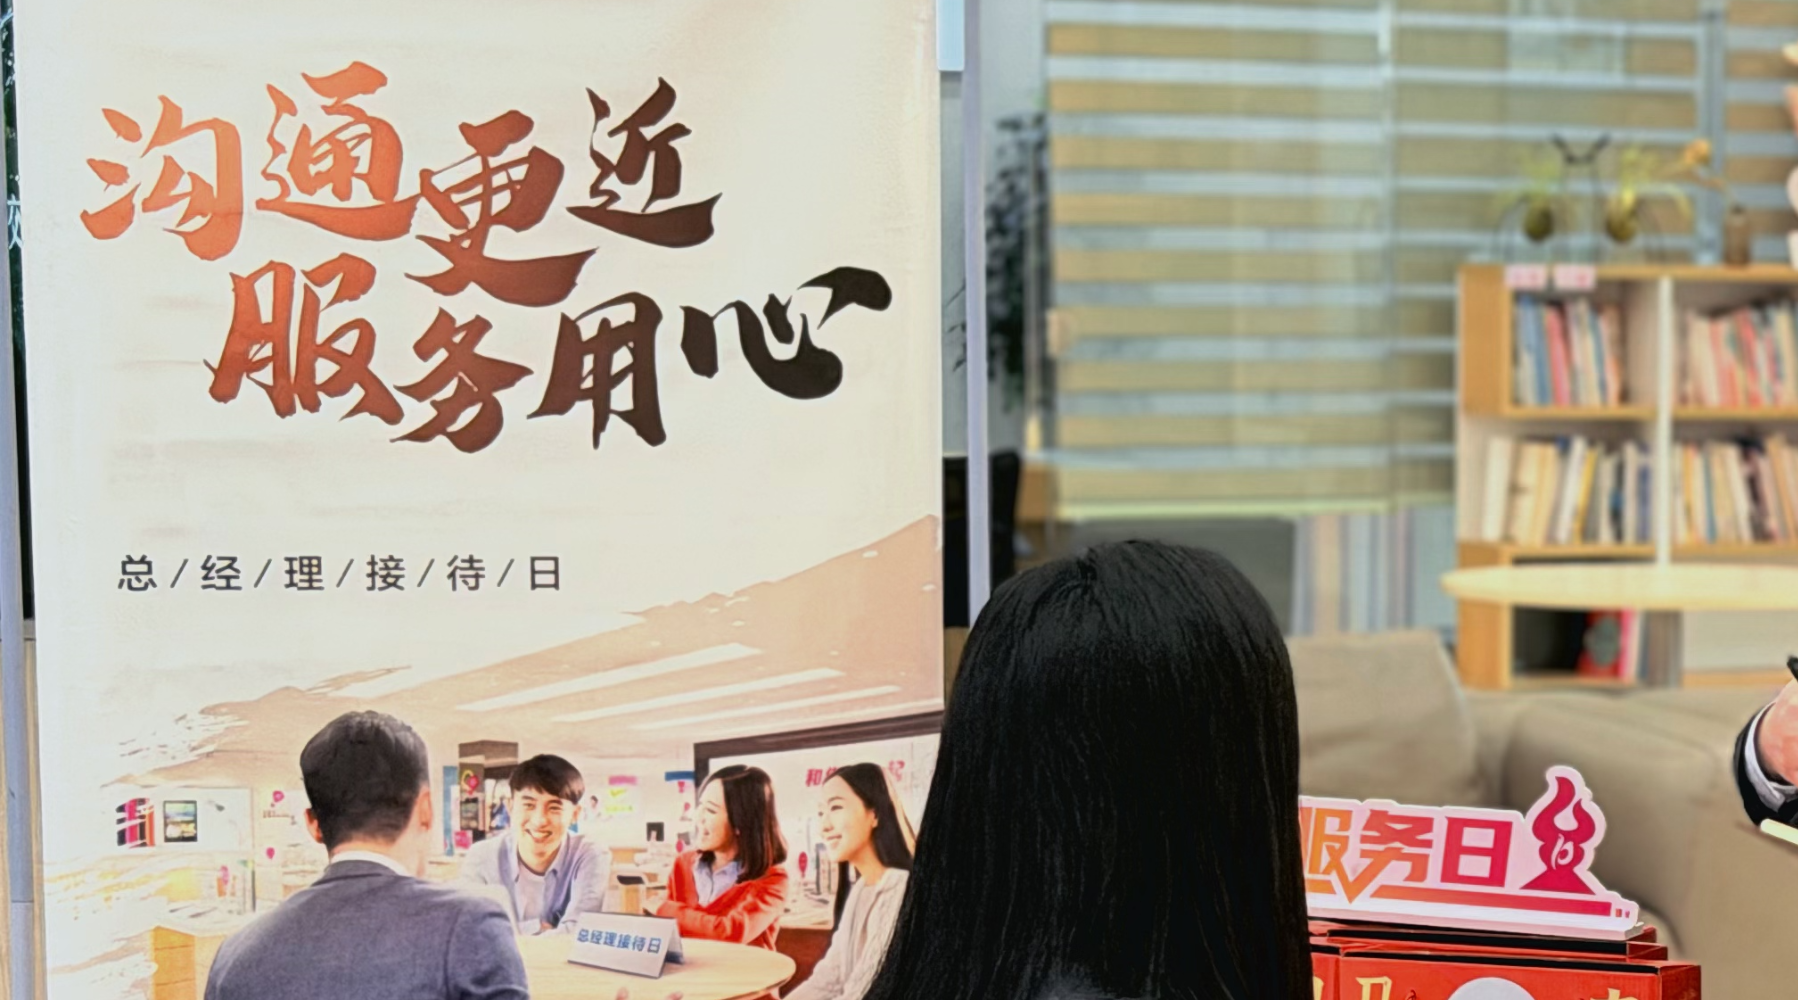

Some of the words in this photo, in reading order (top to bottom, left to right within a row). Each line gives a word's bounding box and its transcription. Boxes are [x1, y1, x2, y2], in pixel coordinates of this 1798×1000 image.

[80, 61, 724, 308] 沟通更近
[203, 252, 893, 454] 服务用心
[577, 928, 662, 954] 总经理接待日
